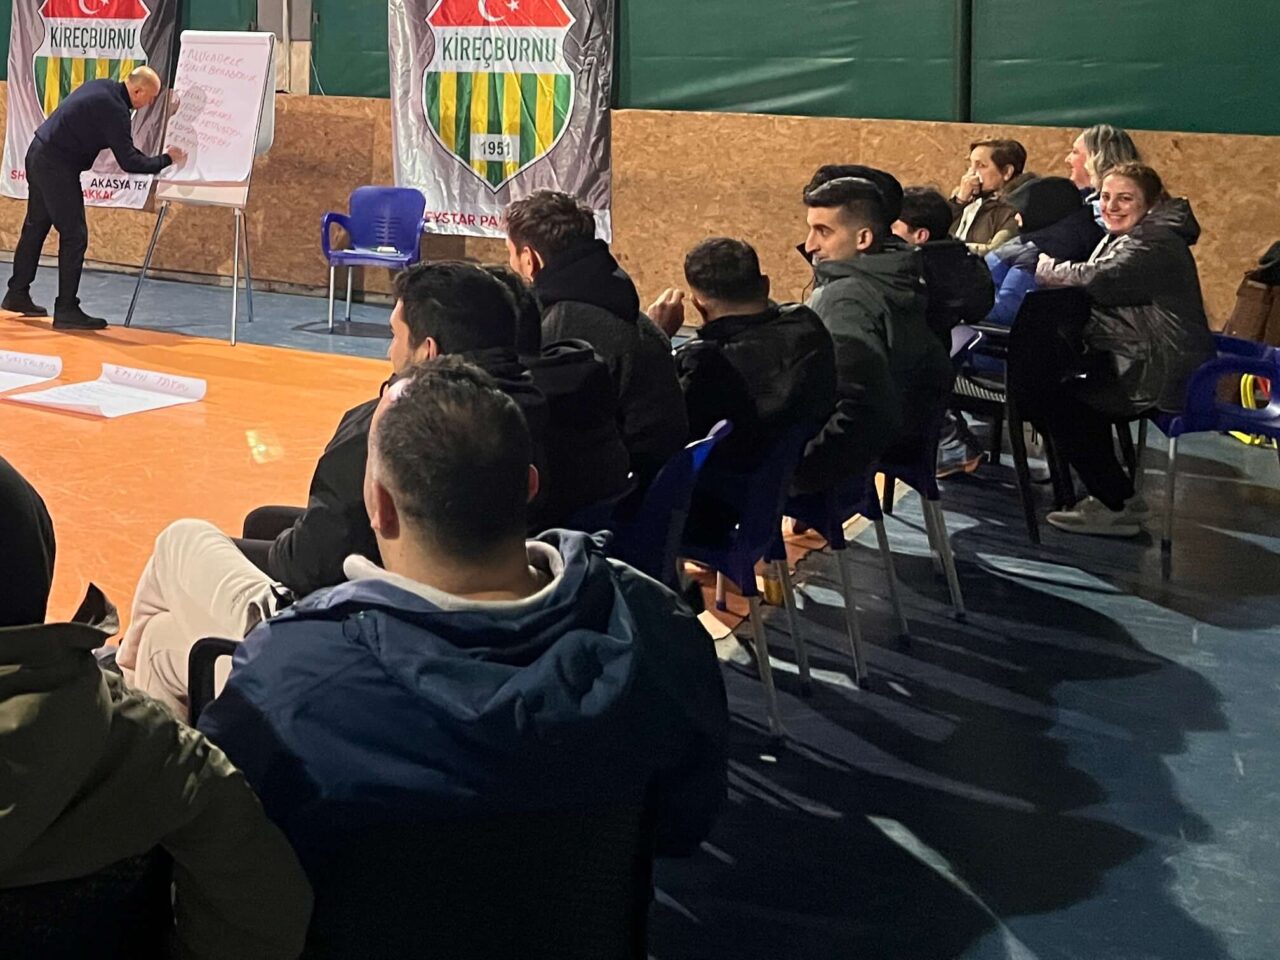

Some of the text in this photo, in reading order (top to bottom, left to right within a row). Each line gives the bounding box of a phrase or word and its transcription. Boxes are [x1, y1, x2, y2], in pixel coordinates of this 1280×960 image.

[50, 23, 137, 55] KİREÇBURNU
[442, 32, 557, 68] KİREÇBURNU
[480, 141, 511, 157] 1951
[90, 178, 131, 190] AKASYA
